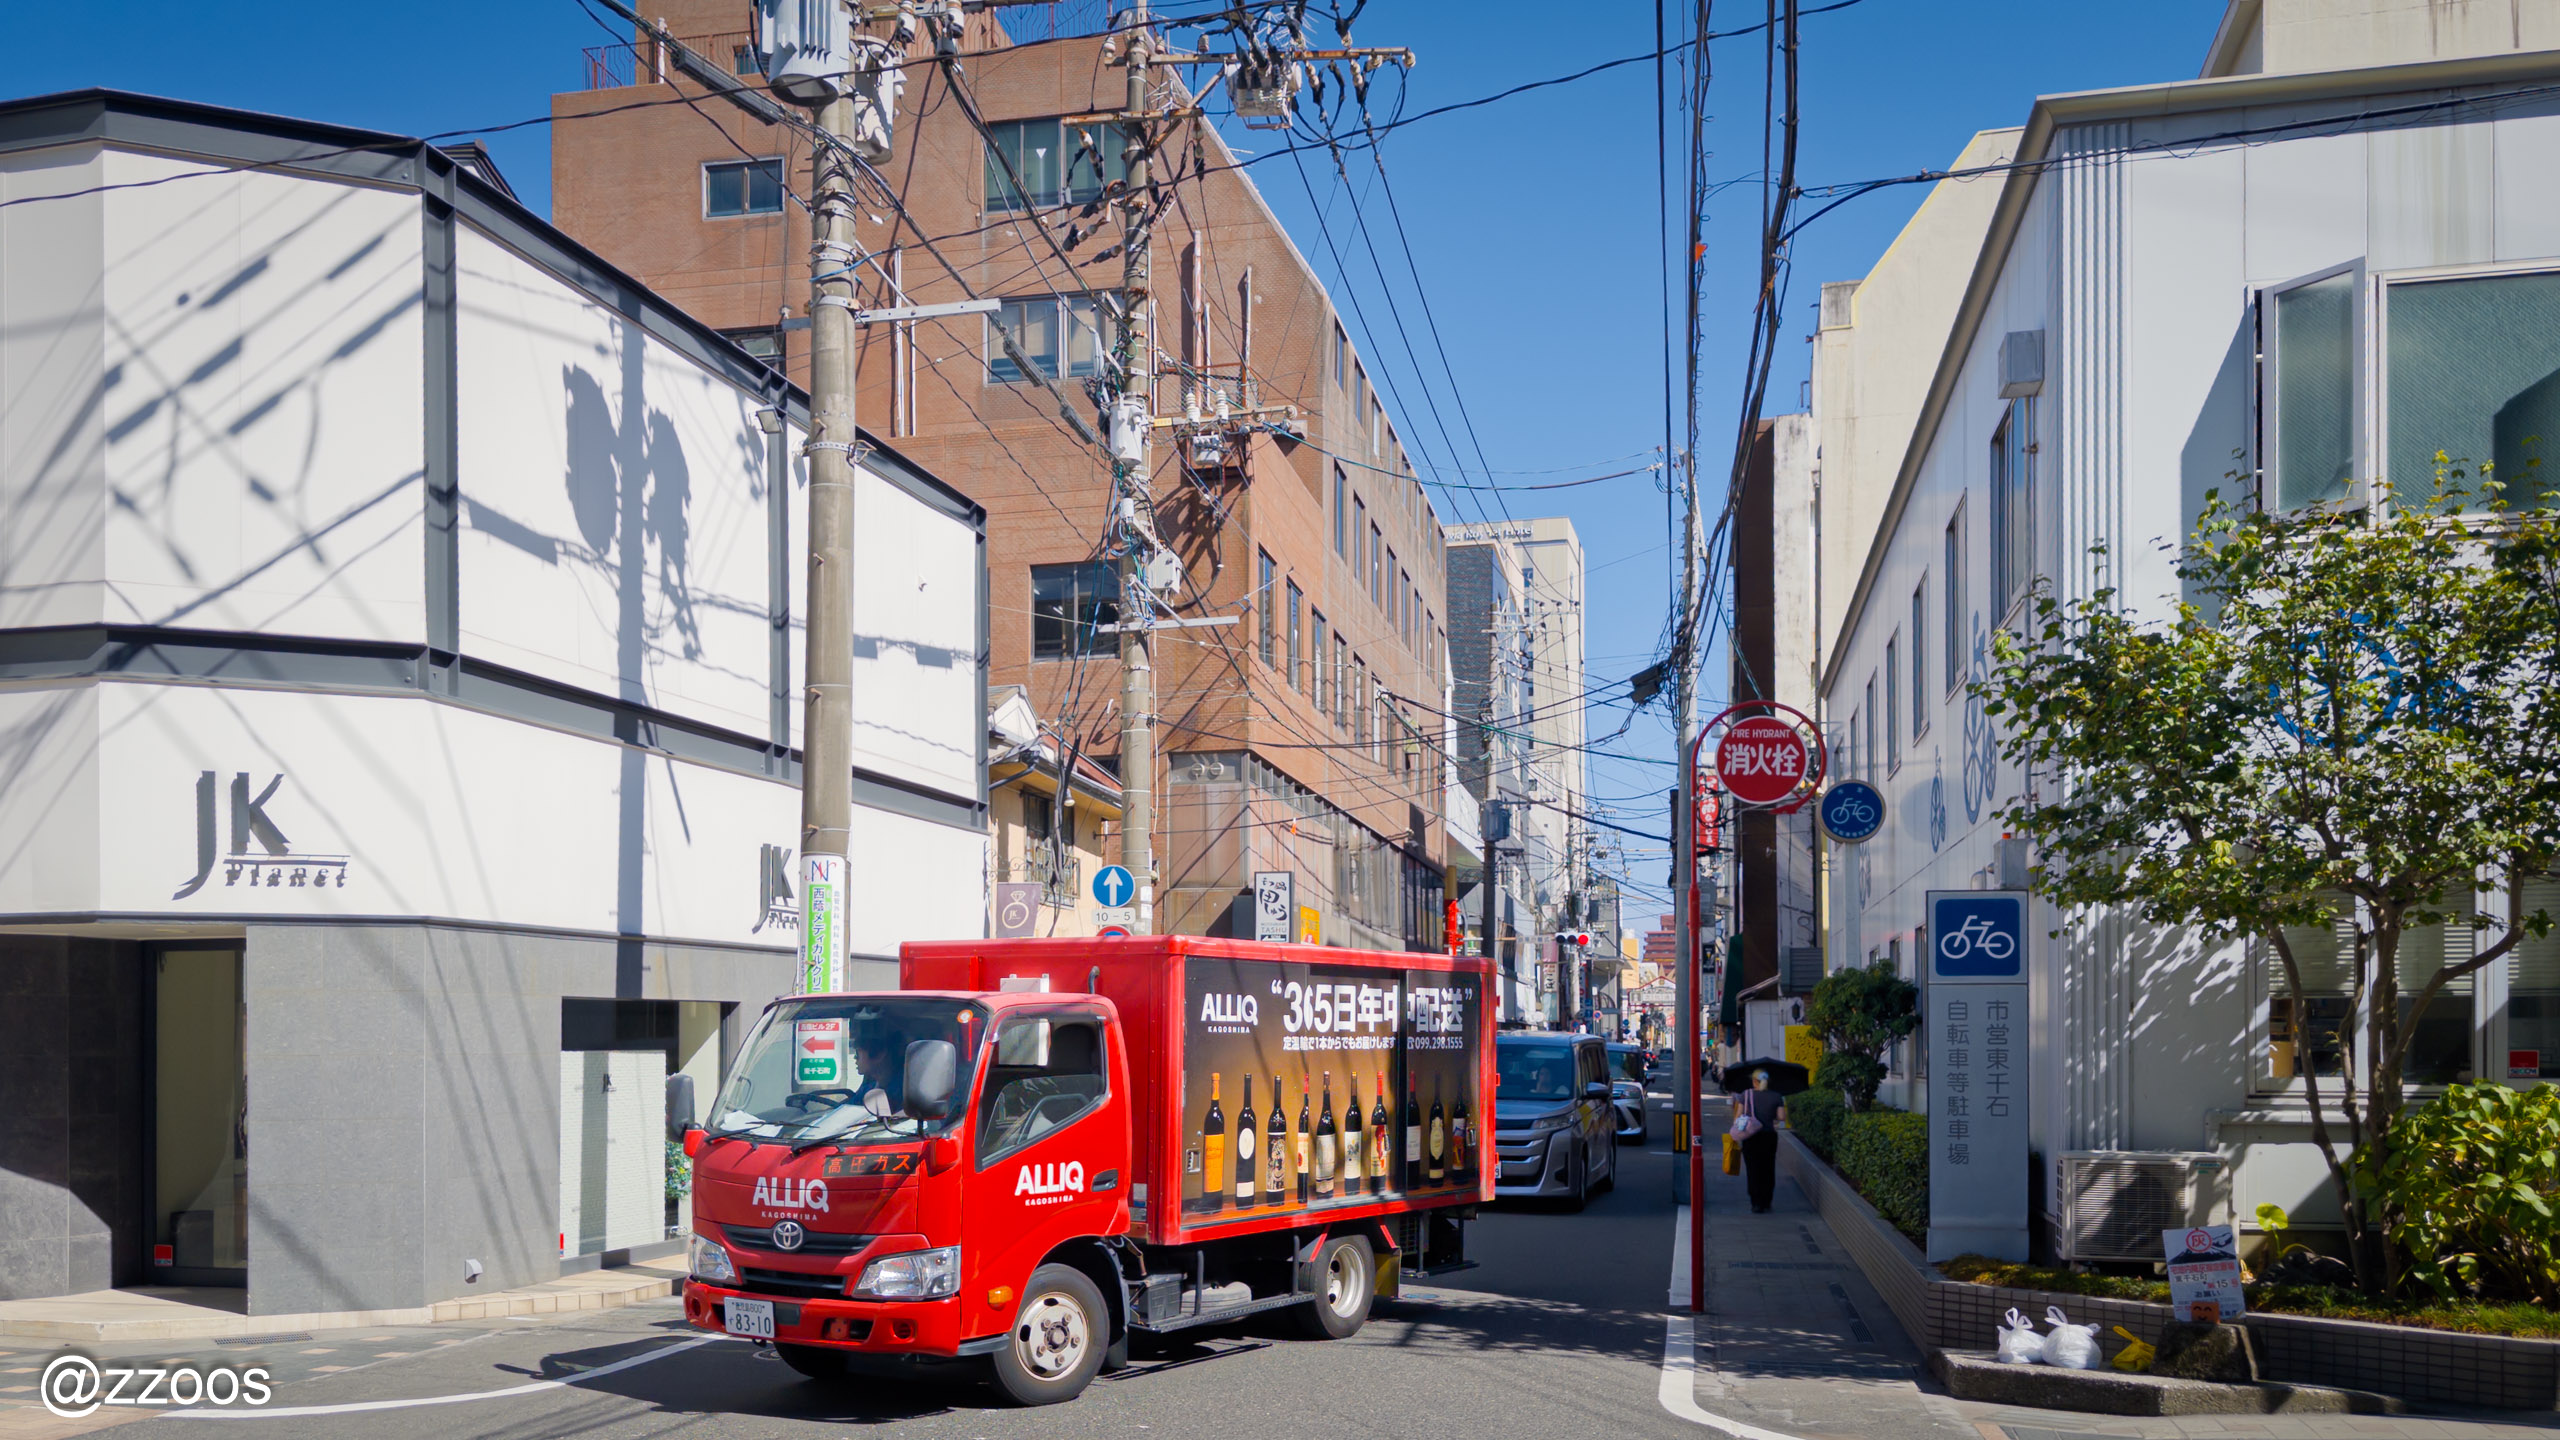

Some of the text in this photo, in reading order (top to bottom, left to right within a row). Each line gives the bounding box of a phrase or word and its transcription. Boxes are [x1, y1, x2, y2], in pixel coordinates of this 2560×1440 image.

[1731, 728, 1791, 739] FIRE HYDRANT
[1723, 743, 1800, 777] 消火栓
[172, 770, 292, 900] JK
[223, 862, 349, 889] Planet
[752, 843, 796, 935] JK
[1096, 911, 1109, 922] 10
[1124, 911, 1131, 921] 5
[1200, 993, 1258, 1026] ALLIQ
[1207, 1026, 1251, 1034] KAGOSHIMA
[1415, 1036, 1464, 1050] 099.298.1555
[1985, 999, 2011, 1119] 市営東千石
[1945, 999, 1971, 1165] 自転車等駐車場
[828, 1154, 911, 1175] 高圧ガス
[1014, 1160, 1084, 1197] ALLIQ
[752, 1176, 830, 1213] ALLIQ
[1024, 1194, 1074, 1207] KAGOSHIMA
[761, 1210, 818, 1221] KAGOSHIMA
[2191, 1234, 2207, 1248] 灰
